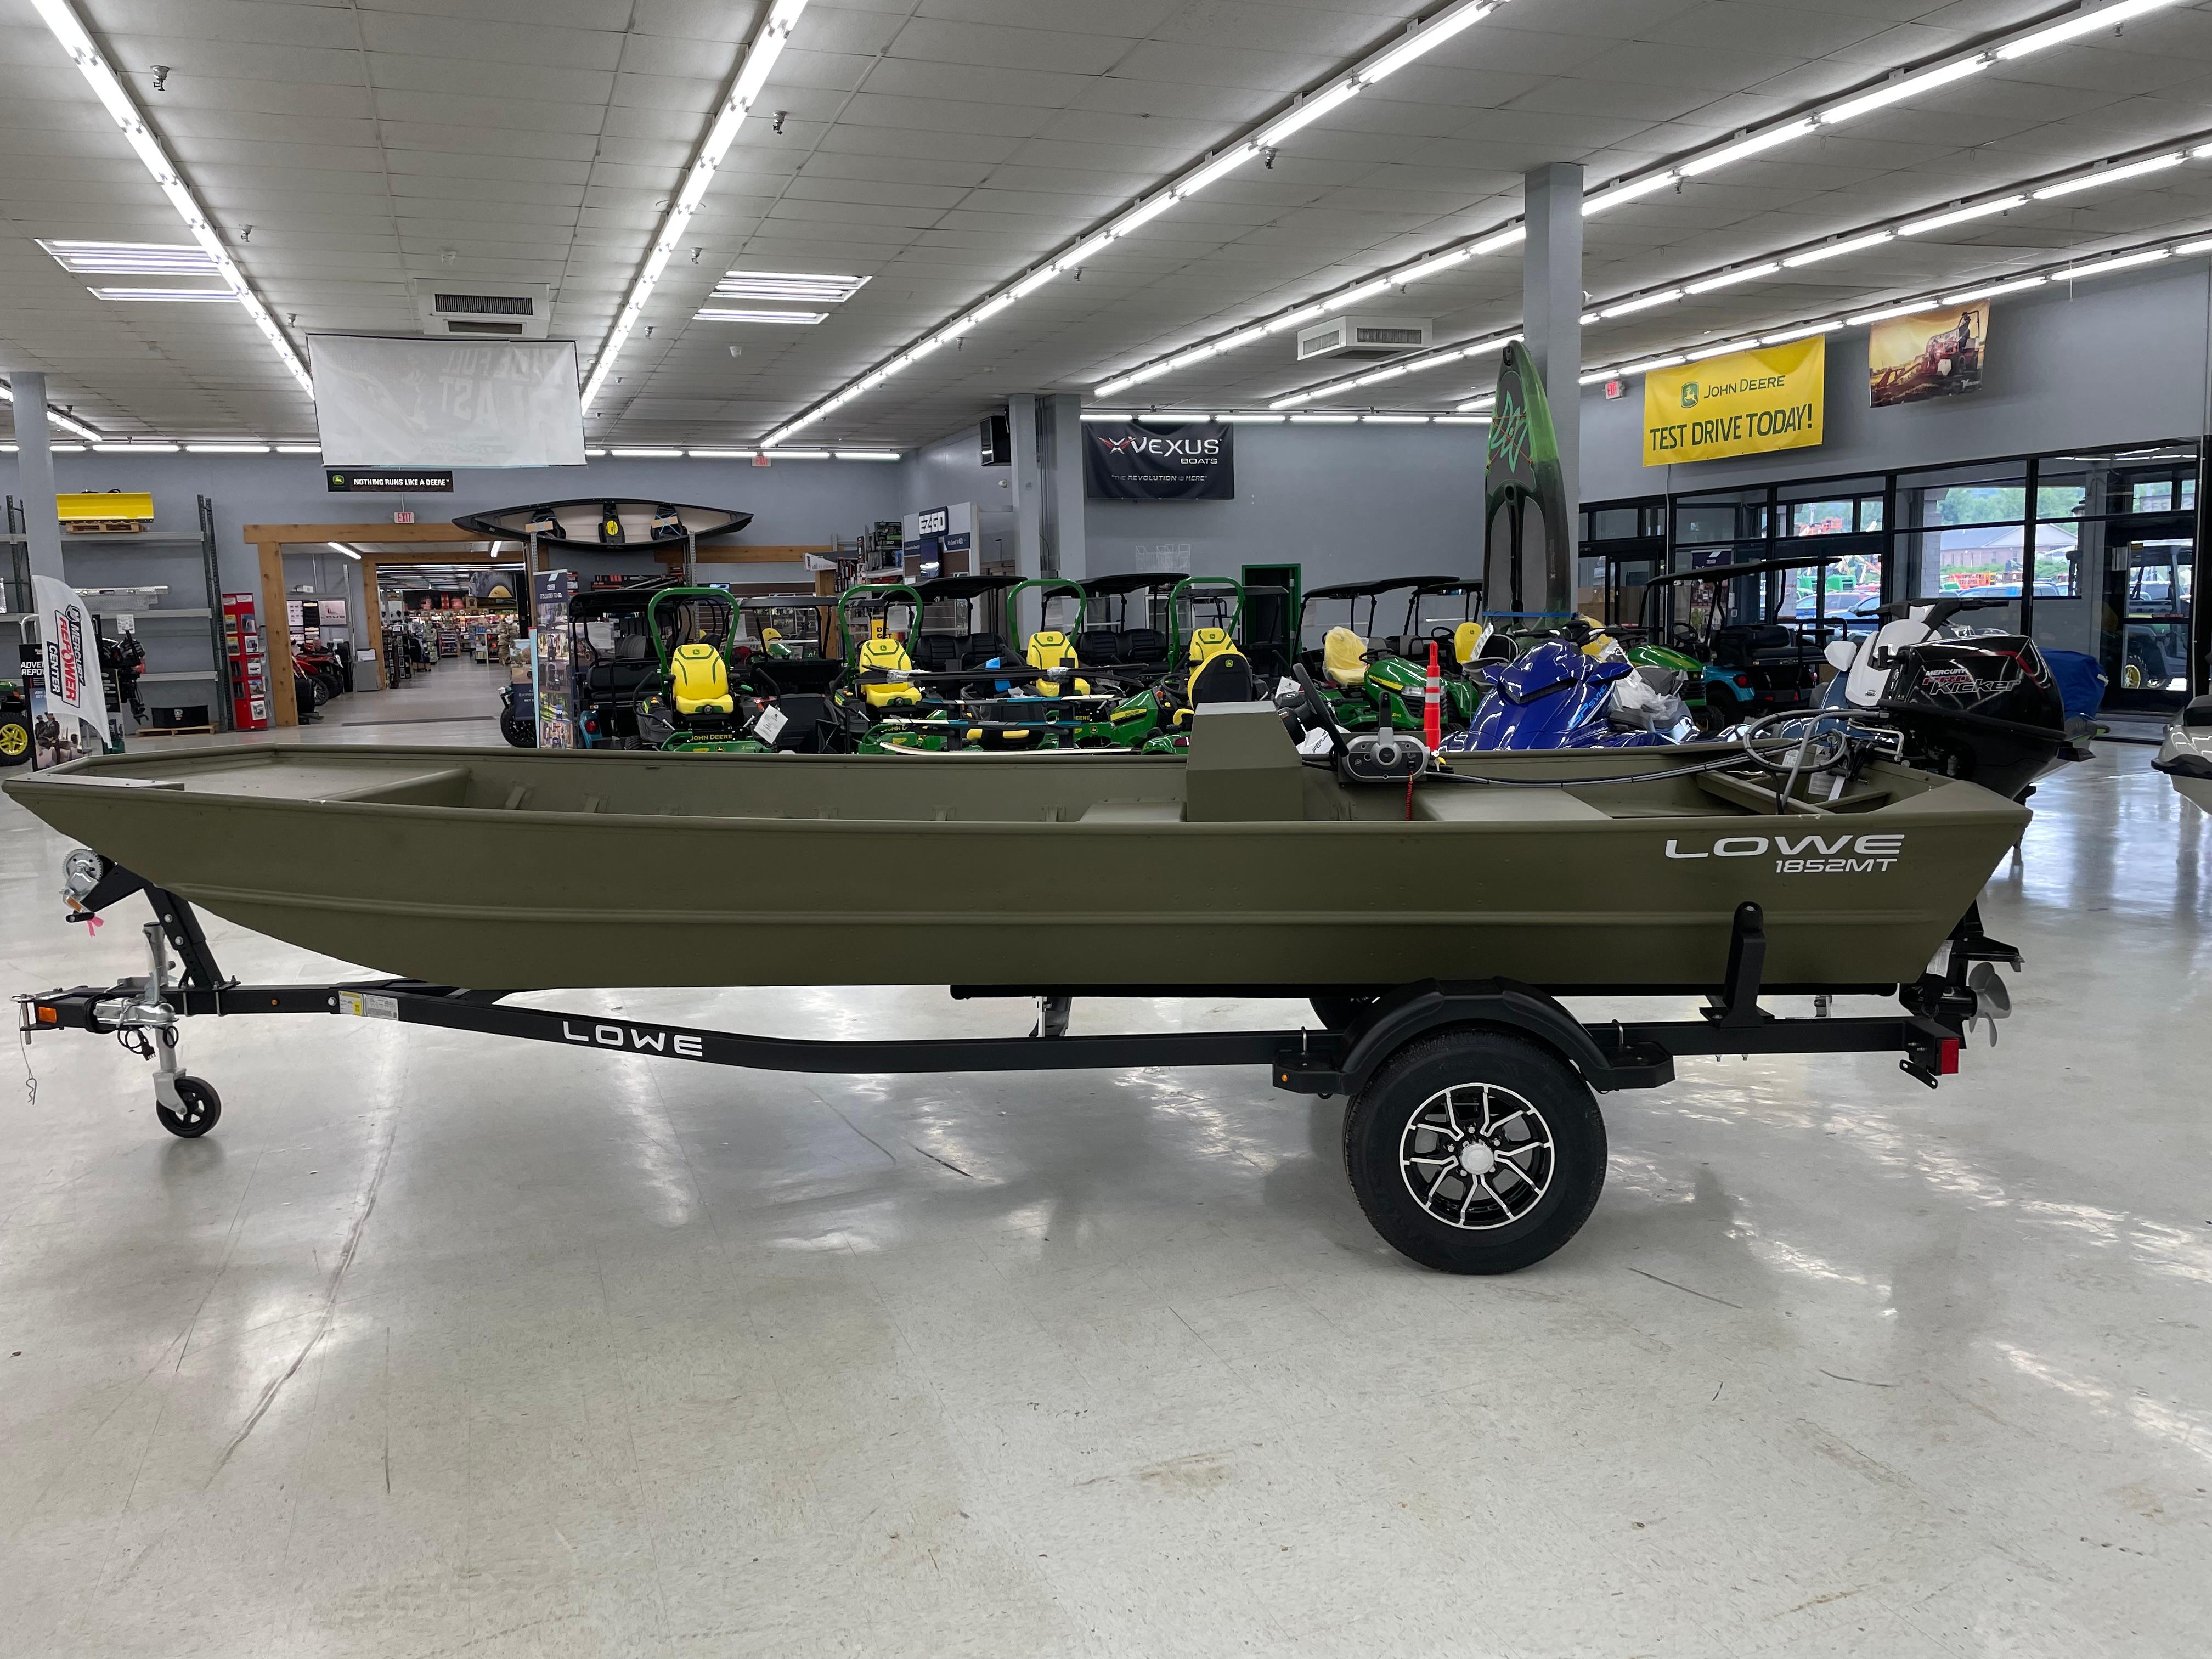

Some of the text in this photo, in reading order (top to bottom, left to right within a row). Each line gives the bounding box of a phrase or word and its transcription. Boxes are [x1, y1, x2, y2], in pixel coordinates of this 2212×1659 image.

[1703, 375, 1786, 399] JOHN DEERE
[1650, 403, 1812, 451] TEST DRIVE TODAY!
[1128, 436, 1220, 457] VEXUS
[397, 512, 411, 522] EXIT
[59, 617, 76, 701] REPOWER
[70, 624, 83, 683] MERCURY
[48, 645, 60, 693] CENTER
[1922, 675, 1972, 685] PRO
[1664, 834, 1905, 859] LOWE
[1776, 858, 1898, 873] 1852MT
[563, 1020, 703, 1057] LOWE
